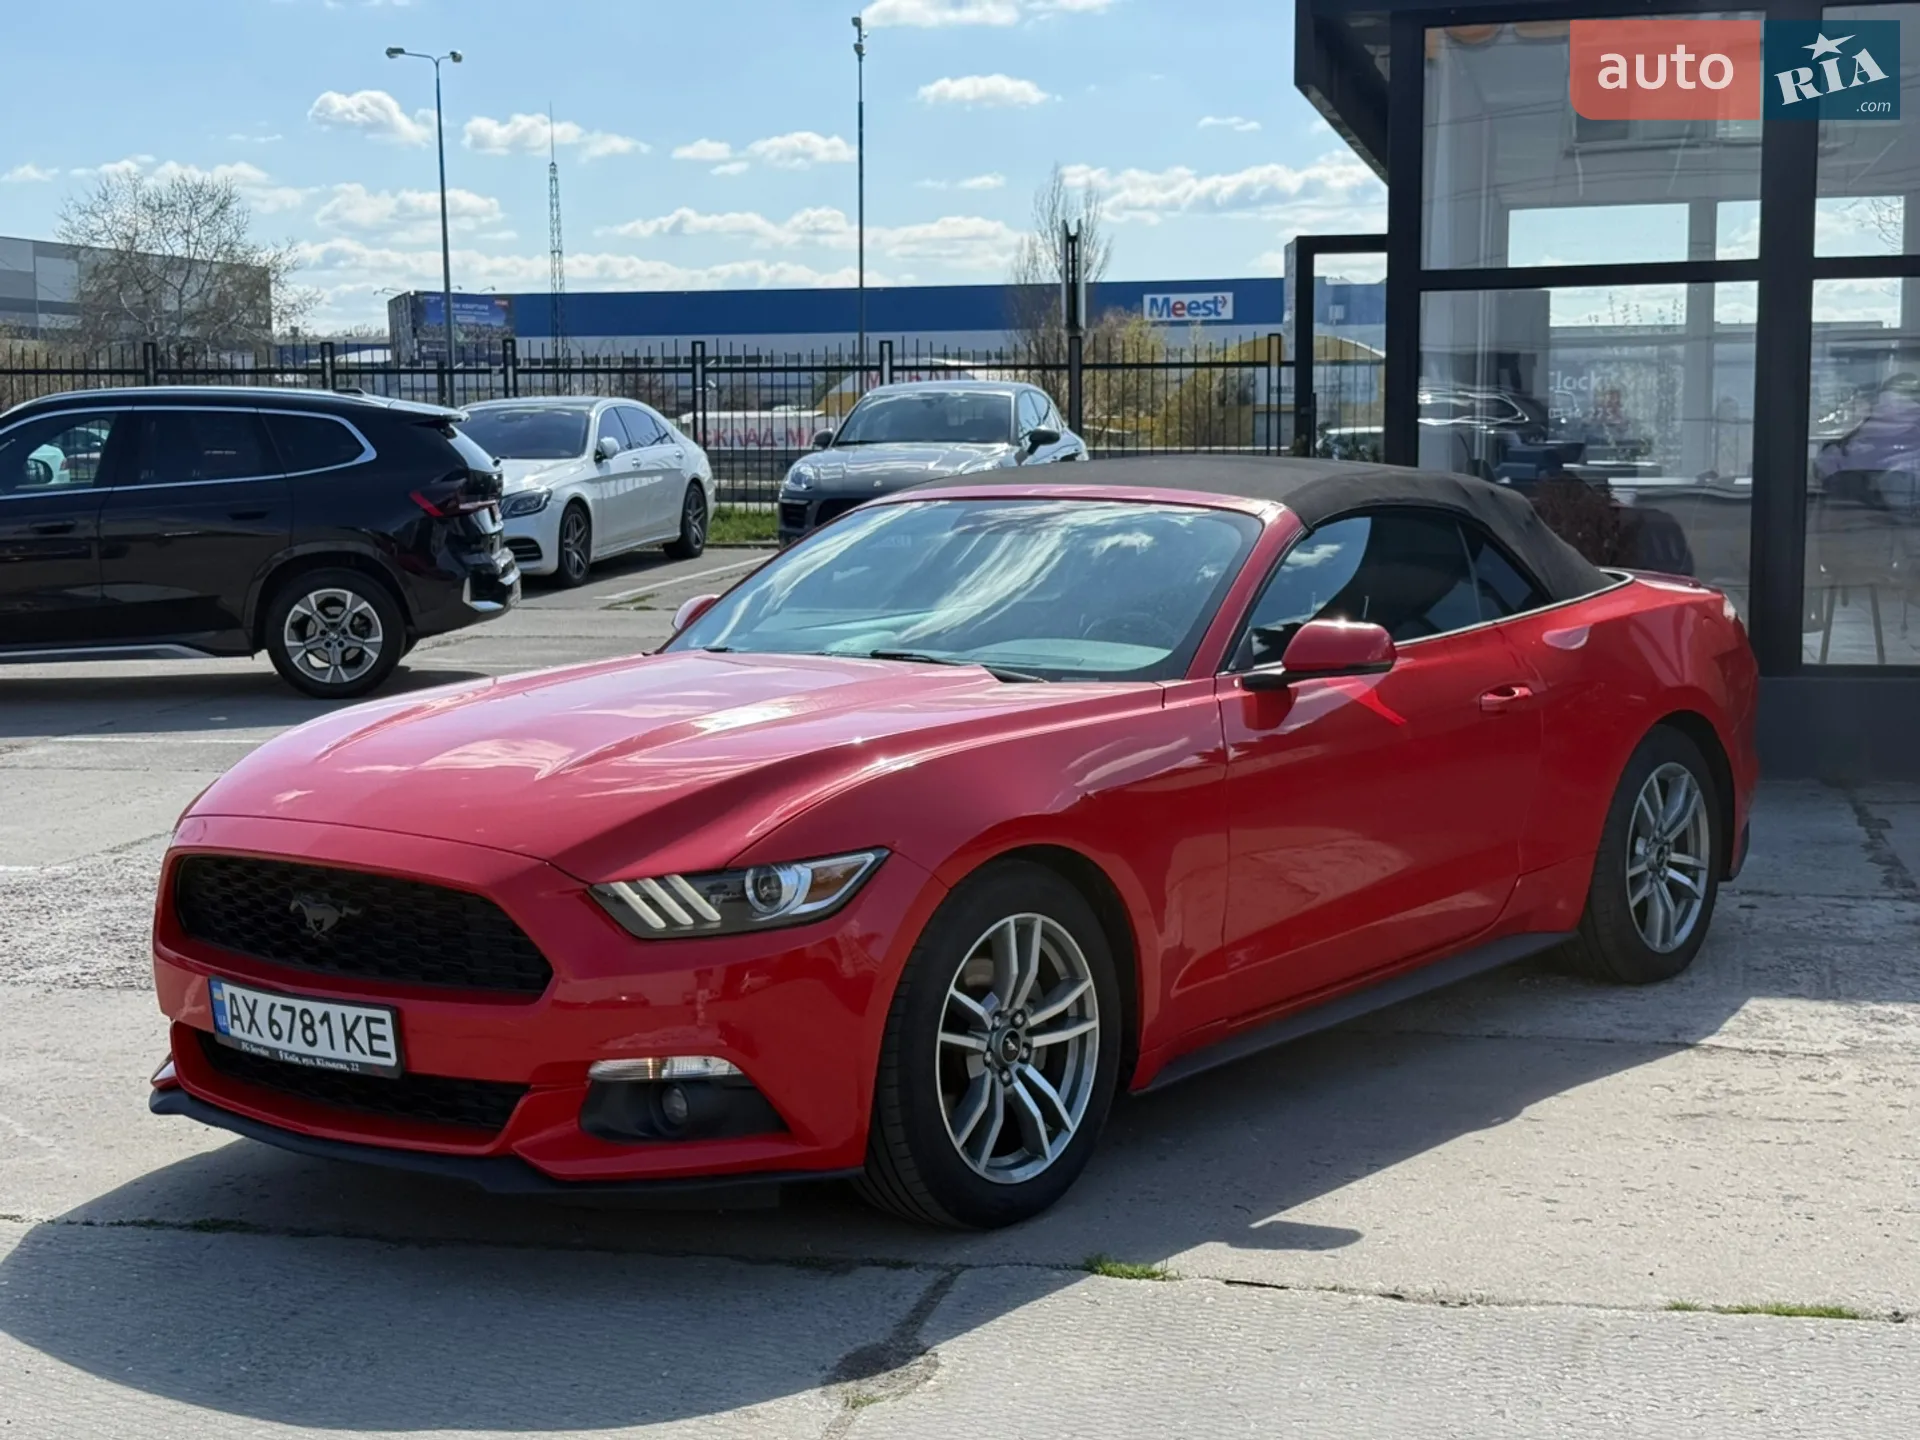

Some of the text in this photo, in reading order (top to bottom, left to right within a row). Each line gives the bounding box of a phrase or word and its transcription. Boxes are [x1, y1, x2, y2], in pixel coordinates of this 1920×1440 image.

[1148, 295, 1222, 319] Meest
[267, 1002, 336, 1051] 6781
[341, 1011, 393, 1060] KE
